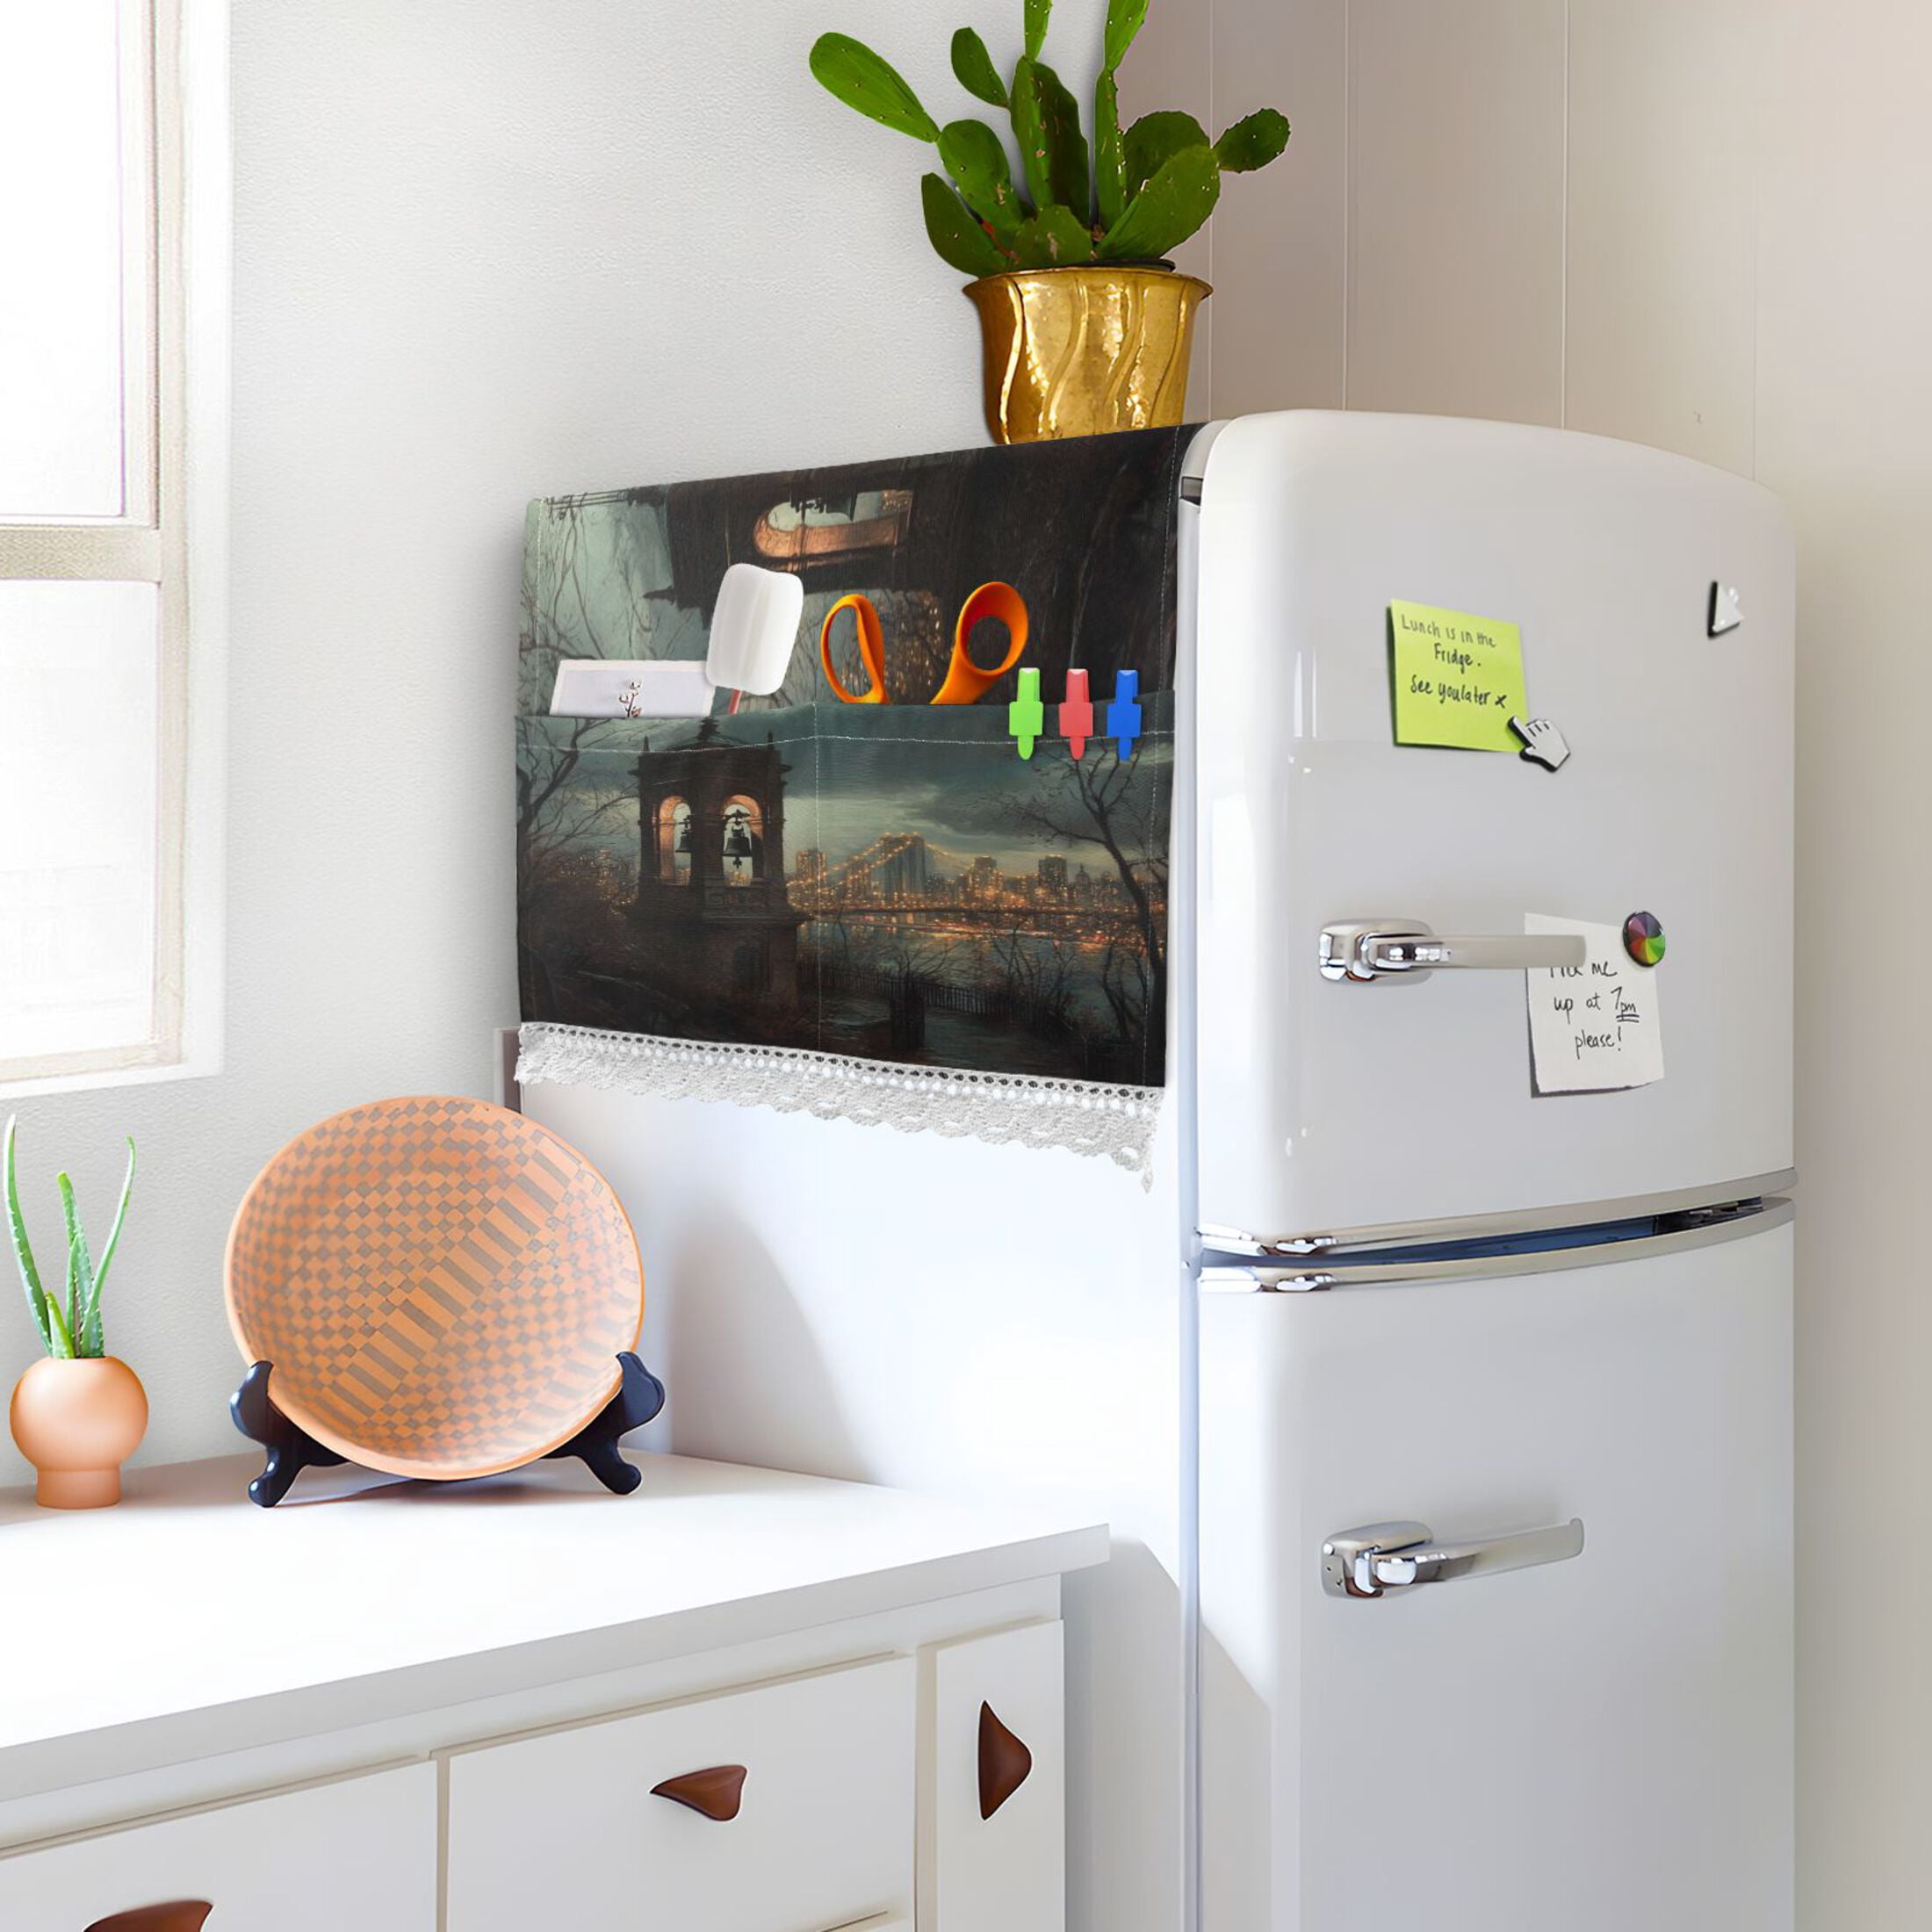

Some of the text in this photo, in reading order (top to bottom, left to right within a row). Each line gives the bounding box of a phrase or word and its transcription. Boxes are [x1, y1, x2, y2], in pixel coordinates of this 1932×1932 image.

[1401, 614, 1440, 638] Lunch
[1477, 632, 1496, 647] the
[1410, 674, 1433, 694] See
[1554, 997, 1574, 1025] up
[1585, 991, 1601, 1011] at
